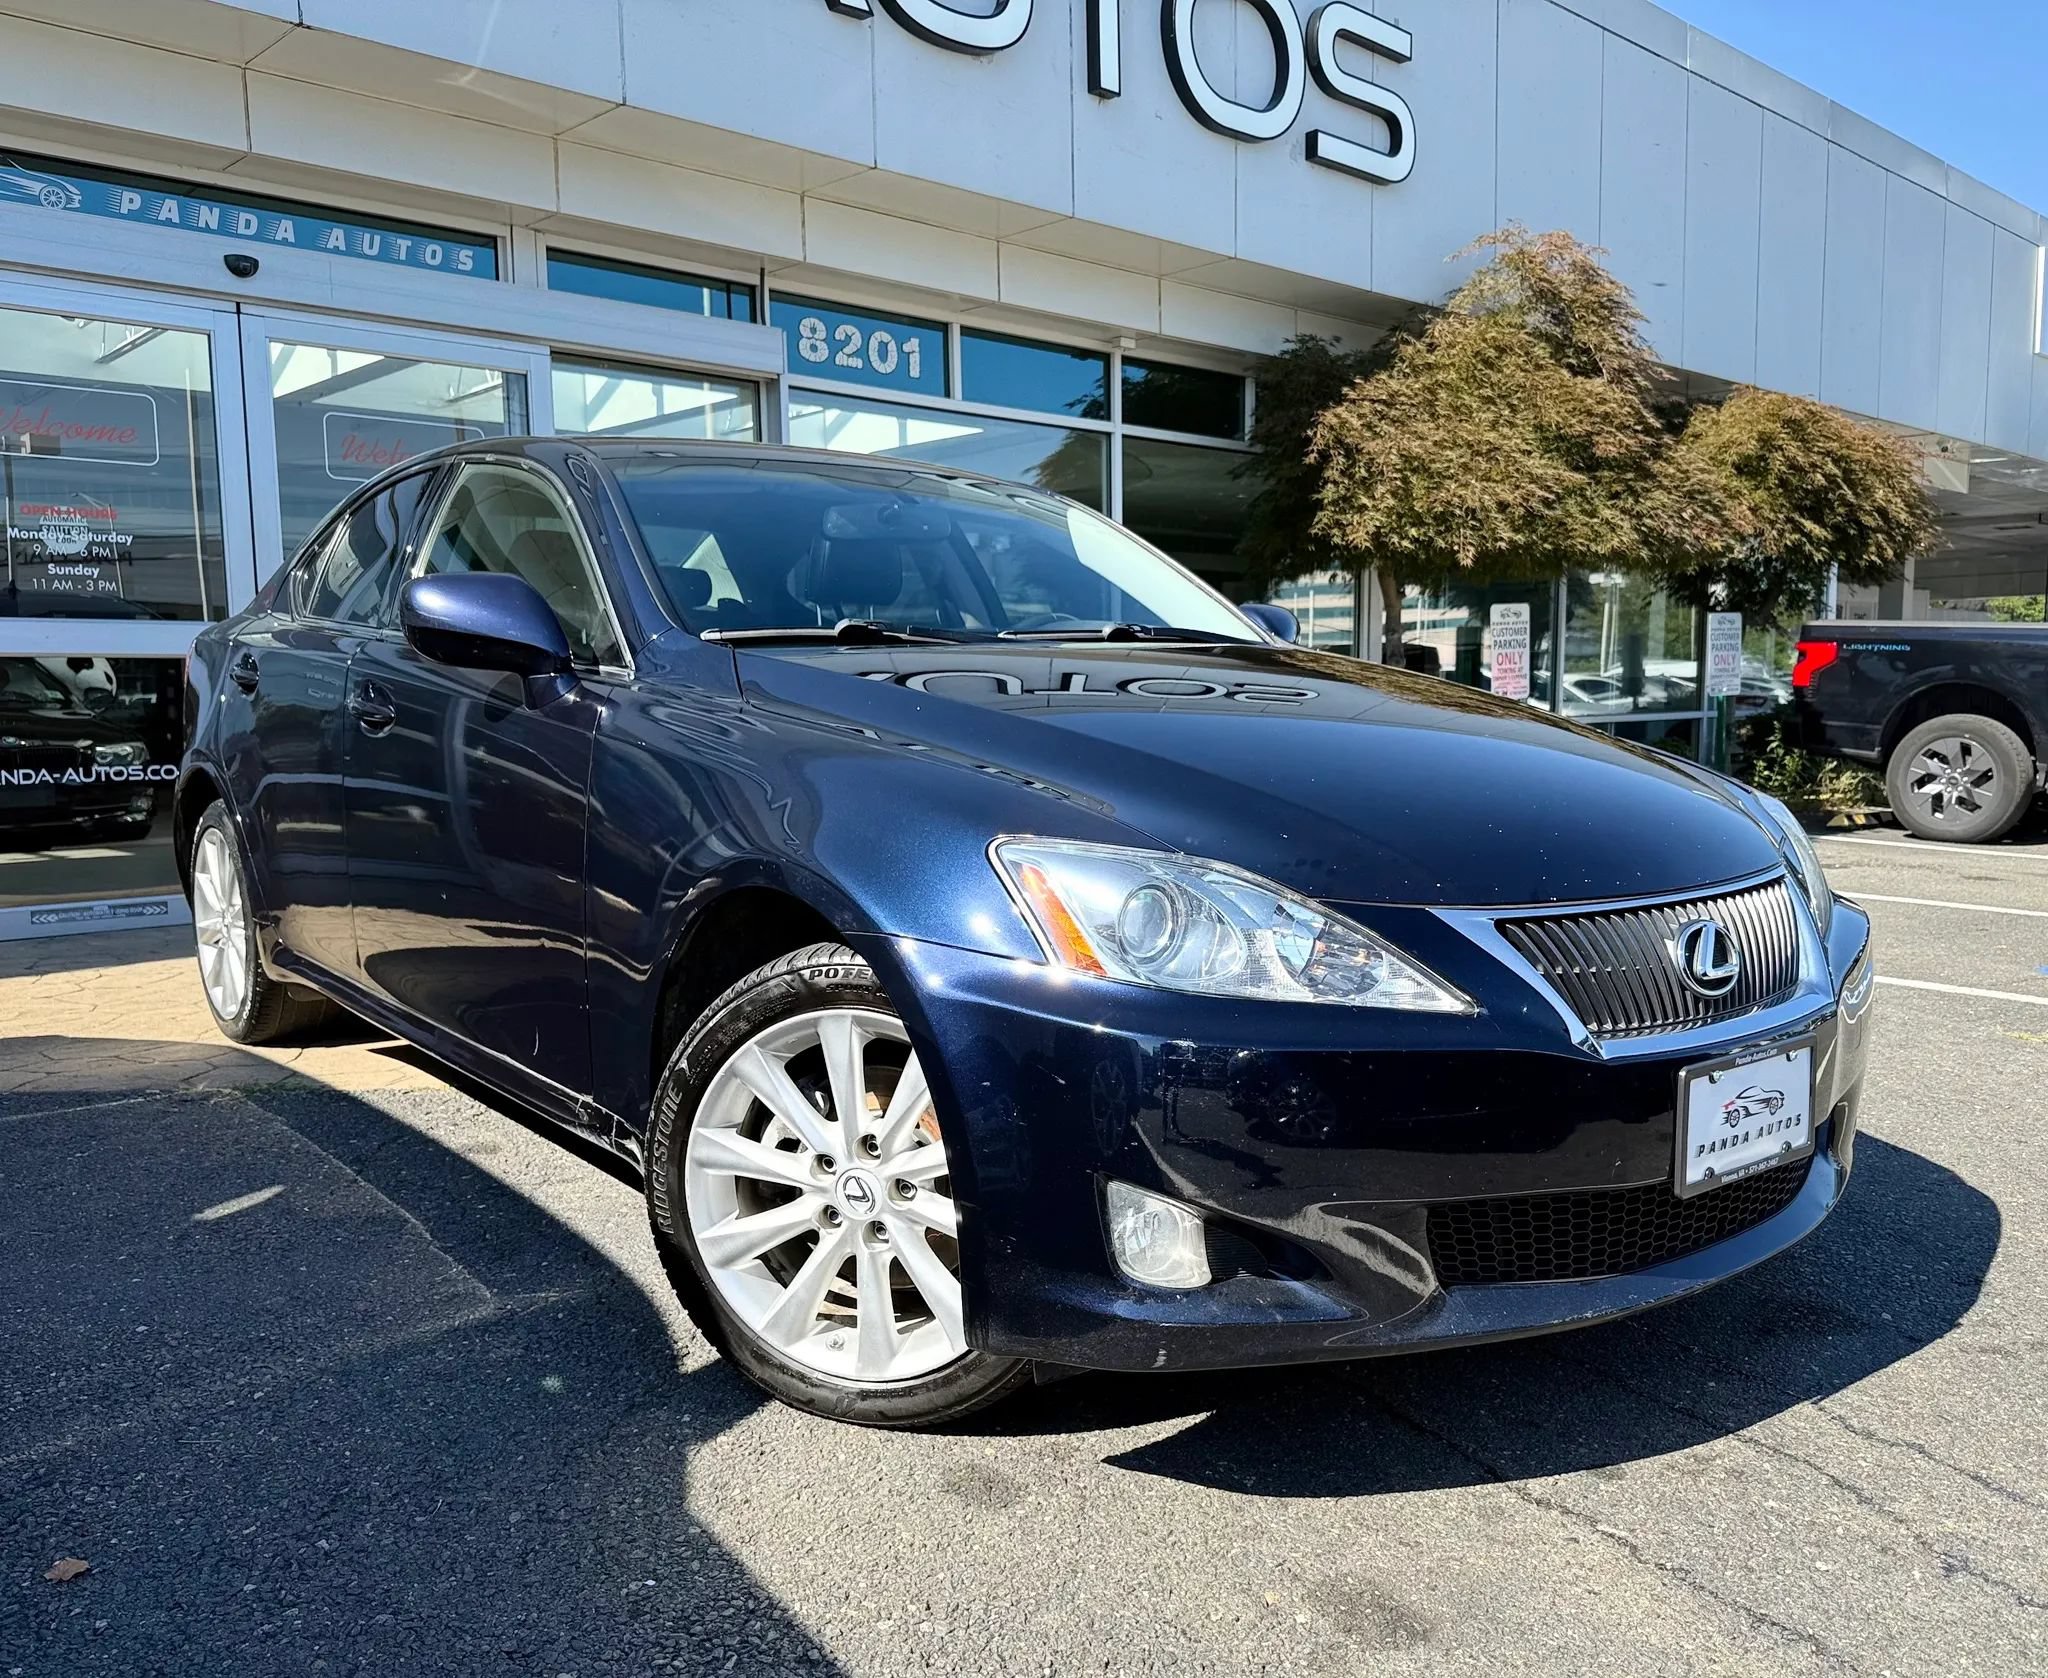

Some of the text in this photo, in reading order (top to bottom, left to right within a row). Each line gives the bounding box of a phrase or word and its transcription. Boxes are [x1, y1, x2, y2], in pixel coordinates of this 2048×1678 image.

[118, 191, 474, 272] PANDA AUTOS
[798, 316, 921, 380] 8201
[33, 544, 111, 558] 9 AM 6 PM
[47, 563, 100, 579] Sunday
[33, 578, 46, 590] 11
[52, 579, 73, 591] AM
[86, 580, 94, 592] 3
[98, 580, 118, 592] PM
[1491, 626, 1528, 638] CUSTOMER
[1711, 632, 1740, 642] CUSTOMER
[1493, 638, 1527, 651] PARKING
[1711, 642, 1739, 653] PARKING
[1842, 643, 1911, 652] LIGHTNING
[1496, 651, 1524, 666] ONLY
[1713, 653, 1736, 667] ONLY
[0, 764, 178, 786] NDA-AUTOS.CO
[1696, 1113, 1802, 1158] PANDA AUTOS
[653, 1081, 683, 1235] RIDGESTONE
